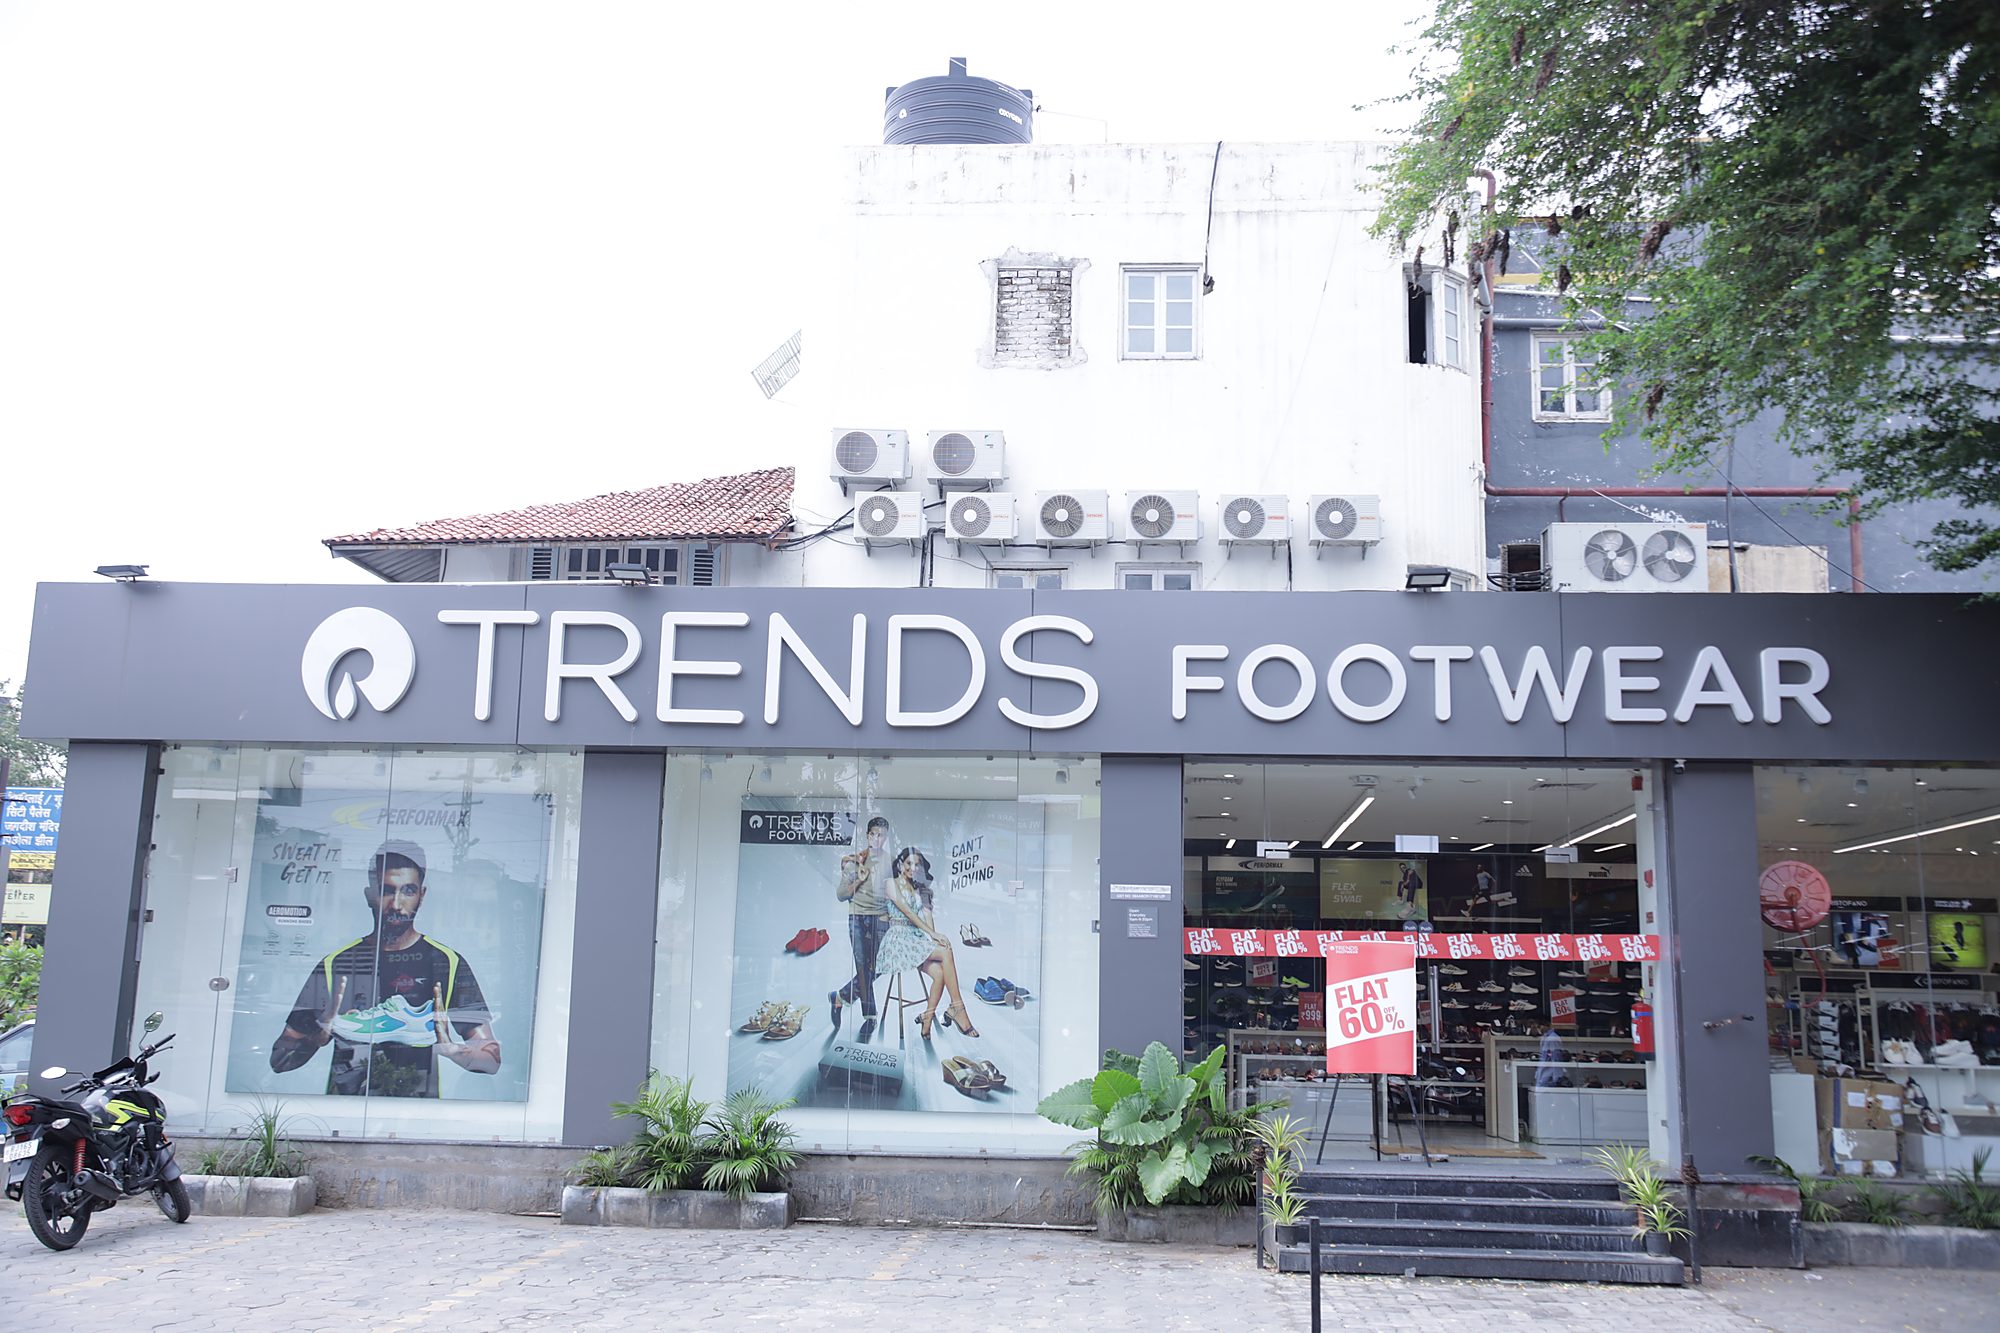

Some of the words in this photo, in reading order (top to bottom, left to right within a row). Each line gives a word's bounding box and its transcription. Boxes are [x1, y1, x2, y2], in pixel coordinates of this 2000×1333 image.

[438, 610, 1099, 730] TRENDS
[1172, 642, 1832, 726] FOOTWEAR
[29, 804, 51, 818] पैलेस
[377, 808, 470, 827] PERFORMAX
[765, 815, 841, 832] TRENDS
[769, 831, 842, 842] FOOTWEAR
[272, 842, 326, 862] SWEAT
[325, 849, 341, 862] IT.
[952, 835, 984, 858] CAN'T
[952, 855, 979, 875] STOP
[280, 862, 317, 884] GET
[316, 870, 332, 884] IT.
[950, 866, 994, 892] MOVING
[268, 906, 307, 916] AEROMOTION
[1188, 928, 1214, 941] FLAT
[1231, 929, 1257, 942] FLAT
[1274, 930, 1299, 943] FLAT
[1317, 931, 1343, 944] FLAT
[1447, 934, 1474, 946] FLAT
[1490, 934, 1517, 947] FLAT
[1534, 934, 1560, 947] FLAT
[1576, 934, 1603, 947] FLAT
[1620, 934, 1647, 948] FLAT
[1190, 939, 1221, 954] 60%
[1233, 940, 1264, 956] 60%
[1276, 941, 1307, 957] 60%
[1415, 942, 1438, 957] 0%
[1449, 943, 1481, 959] 60%
[1493, 943, 1525, 959] 60%
[1536, 944, 1569, 960] 60%
[1579, 944, 1611, 961] 60%
[1622, 944, 1655, 961] 60%
[1334, 978, 1388, 1008] FLAT
[1301, 1010, 1320, 1021] ₹999
[1339, 1002, 1405, 1039] 60%
[844, 1054, 896, 1068] FOOTWEAR
[846, 1048, 897, 1062] TRENDS
